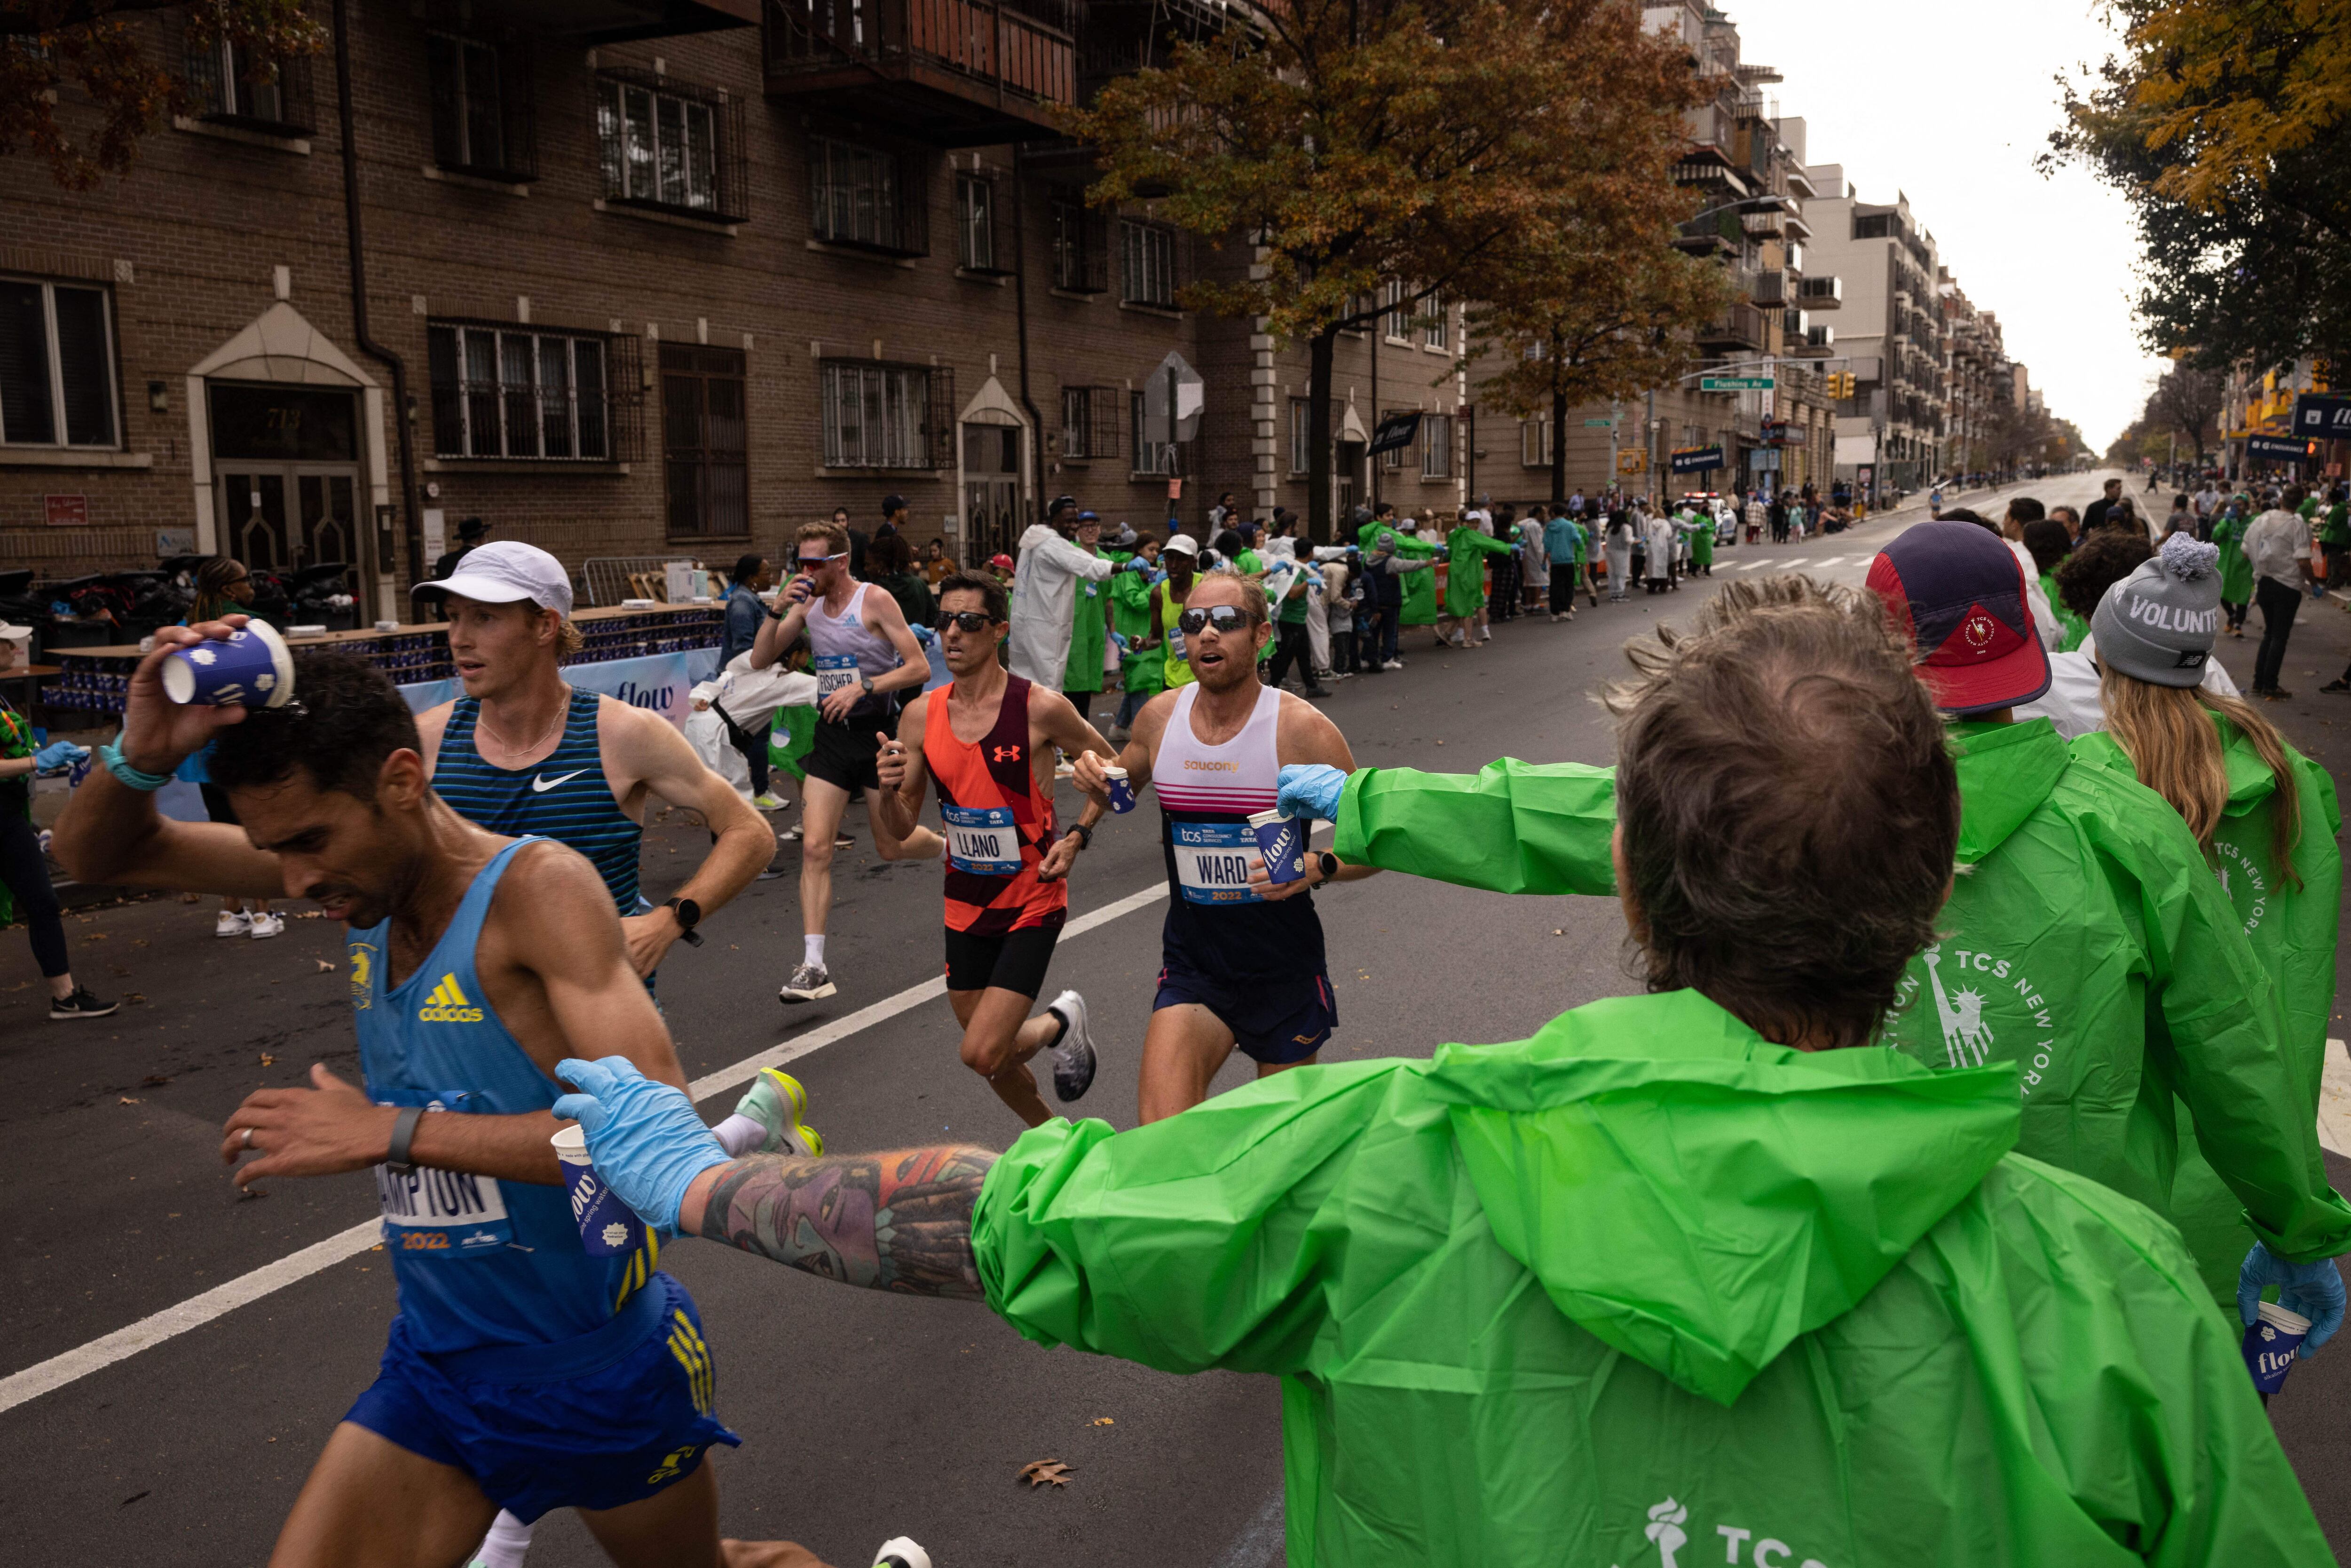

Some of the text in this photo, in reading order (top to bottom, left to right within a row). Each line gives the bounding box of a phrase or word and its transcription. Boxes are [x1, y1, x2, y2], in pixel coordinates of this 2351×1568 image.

[1715, 379, 1748, 388] Flushing
[2332, 407, 2351, 424] fl
[2270, 443, 2304, 454] ENDURANCE
[1965, 624, 1977, 646] MARATHON
[820, 673, 853, 692] FISCHER
[1184, 760, 1239, 773] saucony
[947, 809, 960, 822] tcs
[1182, 828, 1201, 842] tcs
[957, 833, 1000, 858] LLANO
[1263, 827, 1291, 870] flow
[971, 863, 994, 872] 2022
[1196, 856, 1247, 884] WARD
[1273, 859, 1284, 875] alkaline
[1282, 847, 1292, 860] spring
[2214, 842, 2239, 859] TCS
[2240, 857, 2264, 890] NEW
[1212, 891, 1242, 900] 2022
[1955, 951, 2012, 978] TCS
[2013, 978, 2053, 1027] NEW
[418, 1005, 484, 1022] adidas
[584, 1205, 599, 1223] spring
[595, 1186, 609, 1205] water
[401, 1232, 451, 1250] 2022
[2264, 1370, 2282, 1380] alkaline
[1716, 1524, 1828, 1568] TC
